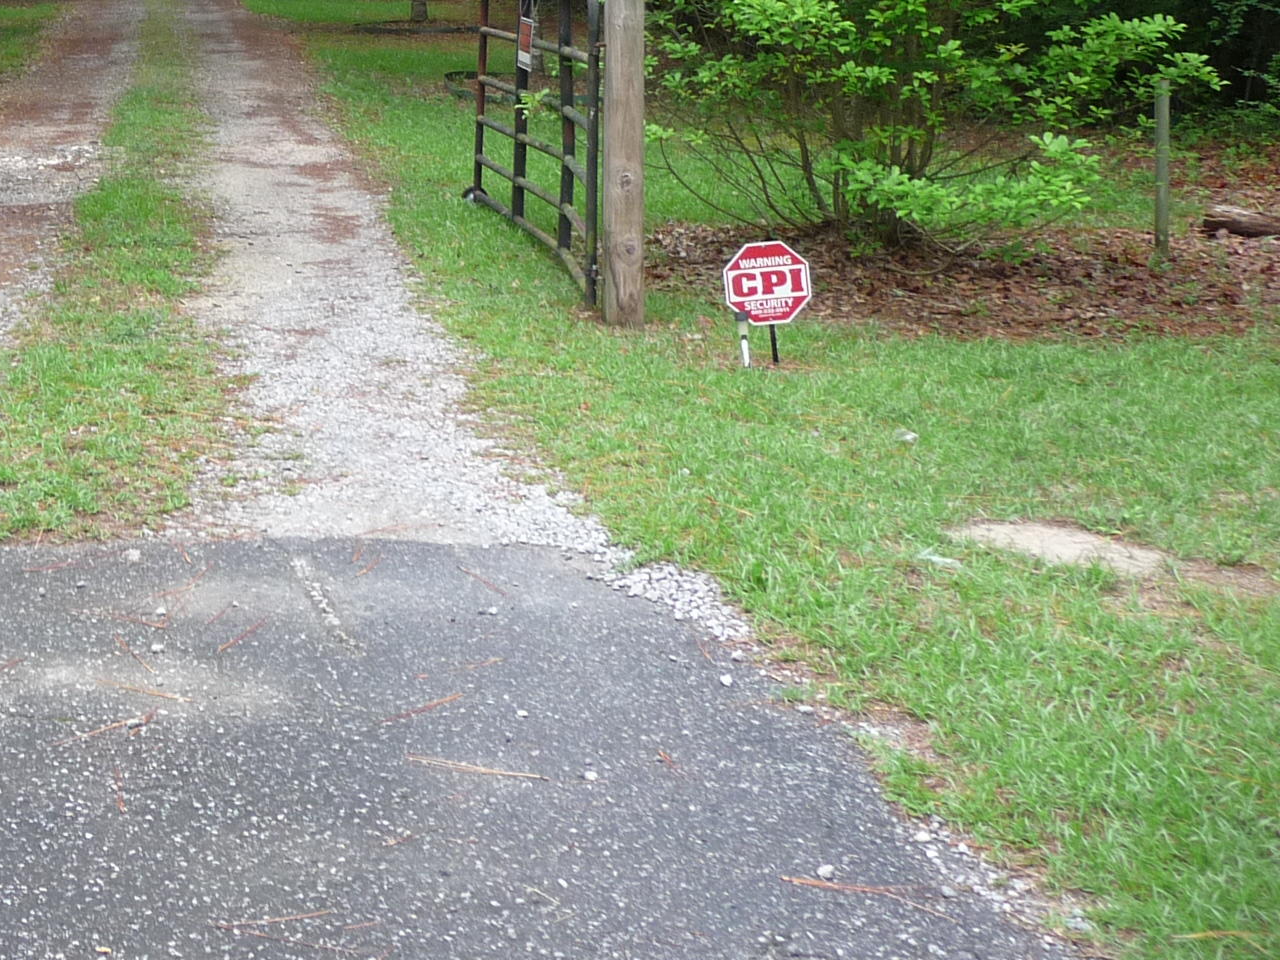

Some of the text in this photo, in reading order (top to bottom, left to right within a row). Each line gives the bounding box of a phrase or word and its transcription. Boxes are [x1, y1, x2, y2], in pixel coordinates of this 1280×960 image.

[738, 255, 792, 268] WARNING
[732, 268, 804, 297] CPI
[744, 298, 793, 311] SECURITY
